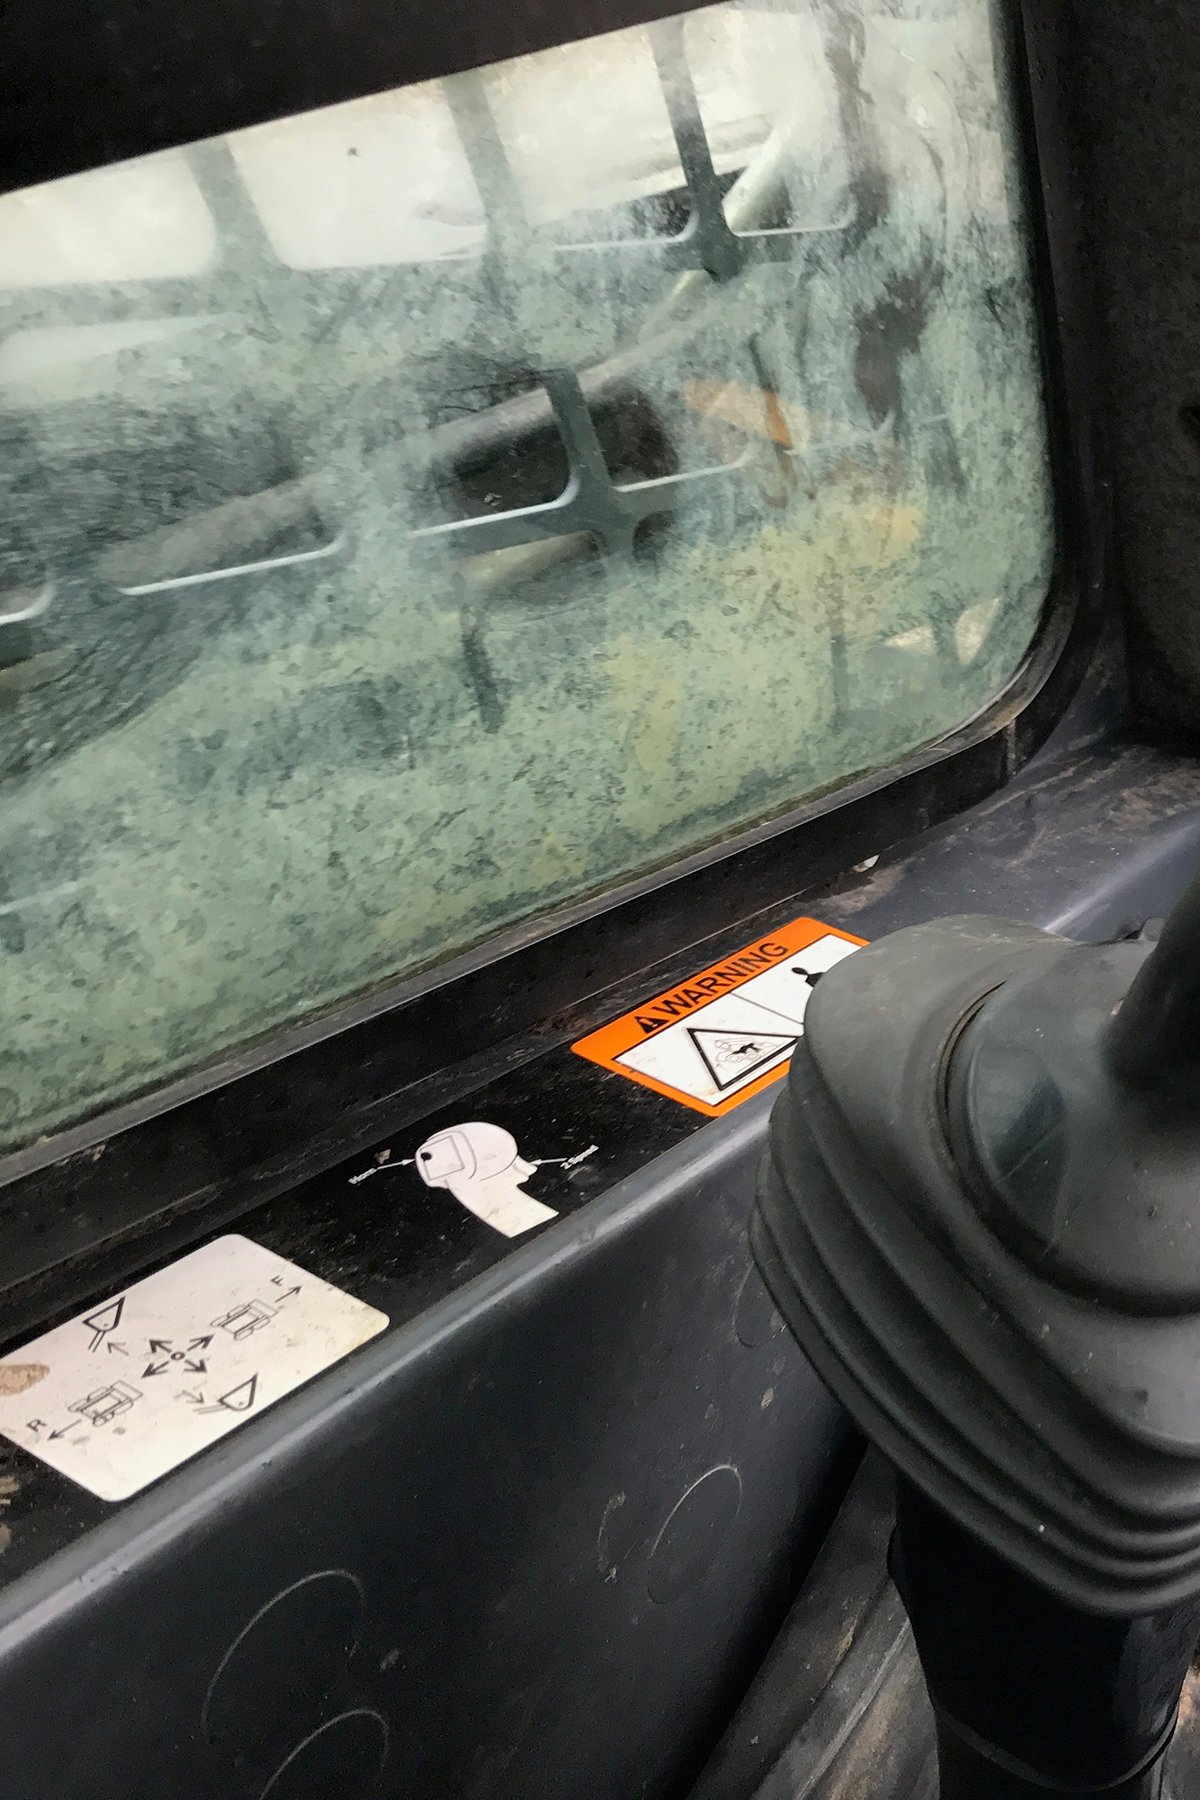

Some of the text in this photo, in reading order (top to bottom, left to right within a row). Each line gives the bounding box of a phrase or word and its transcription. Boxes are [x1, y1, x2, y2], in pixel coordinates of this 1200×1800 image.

[653, 942, 789, 1016] WARNING
[270, 1275, 284, 1287] F
[26, 1419, 47, 1432] R
